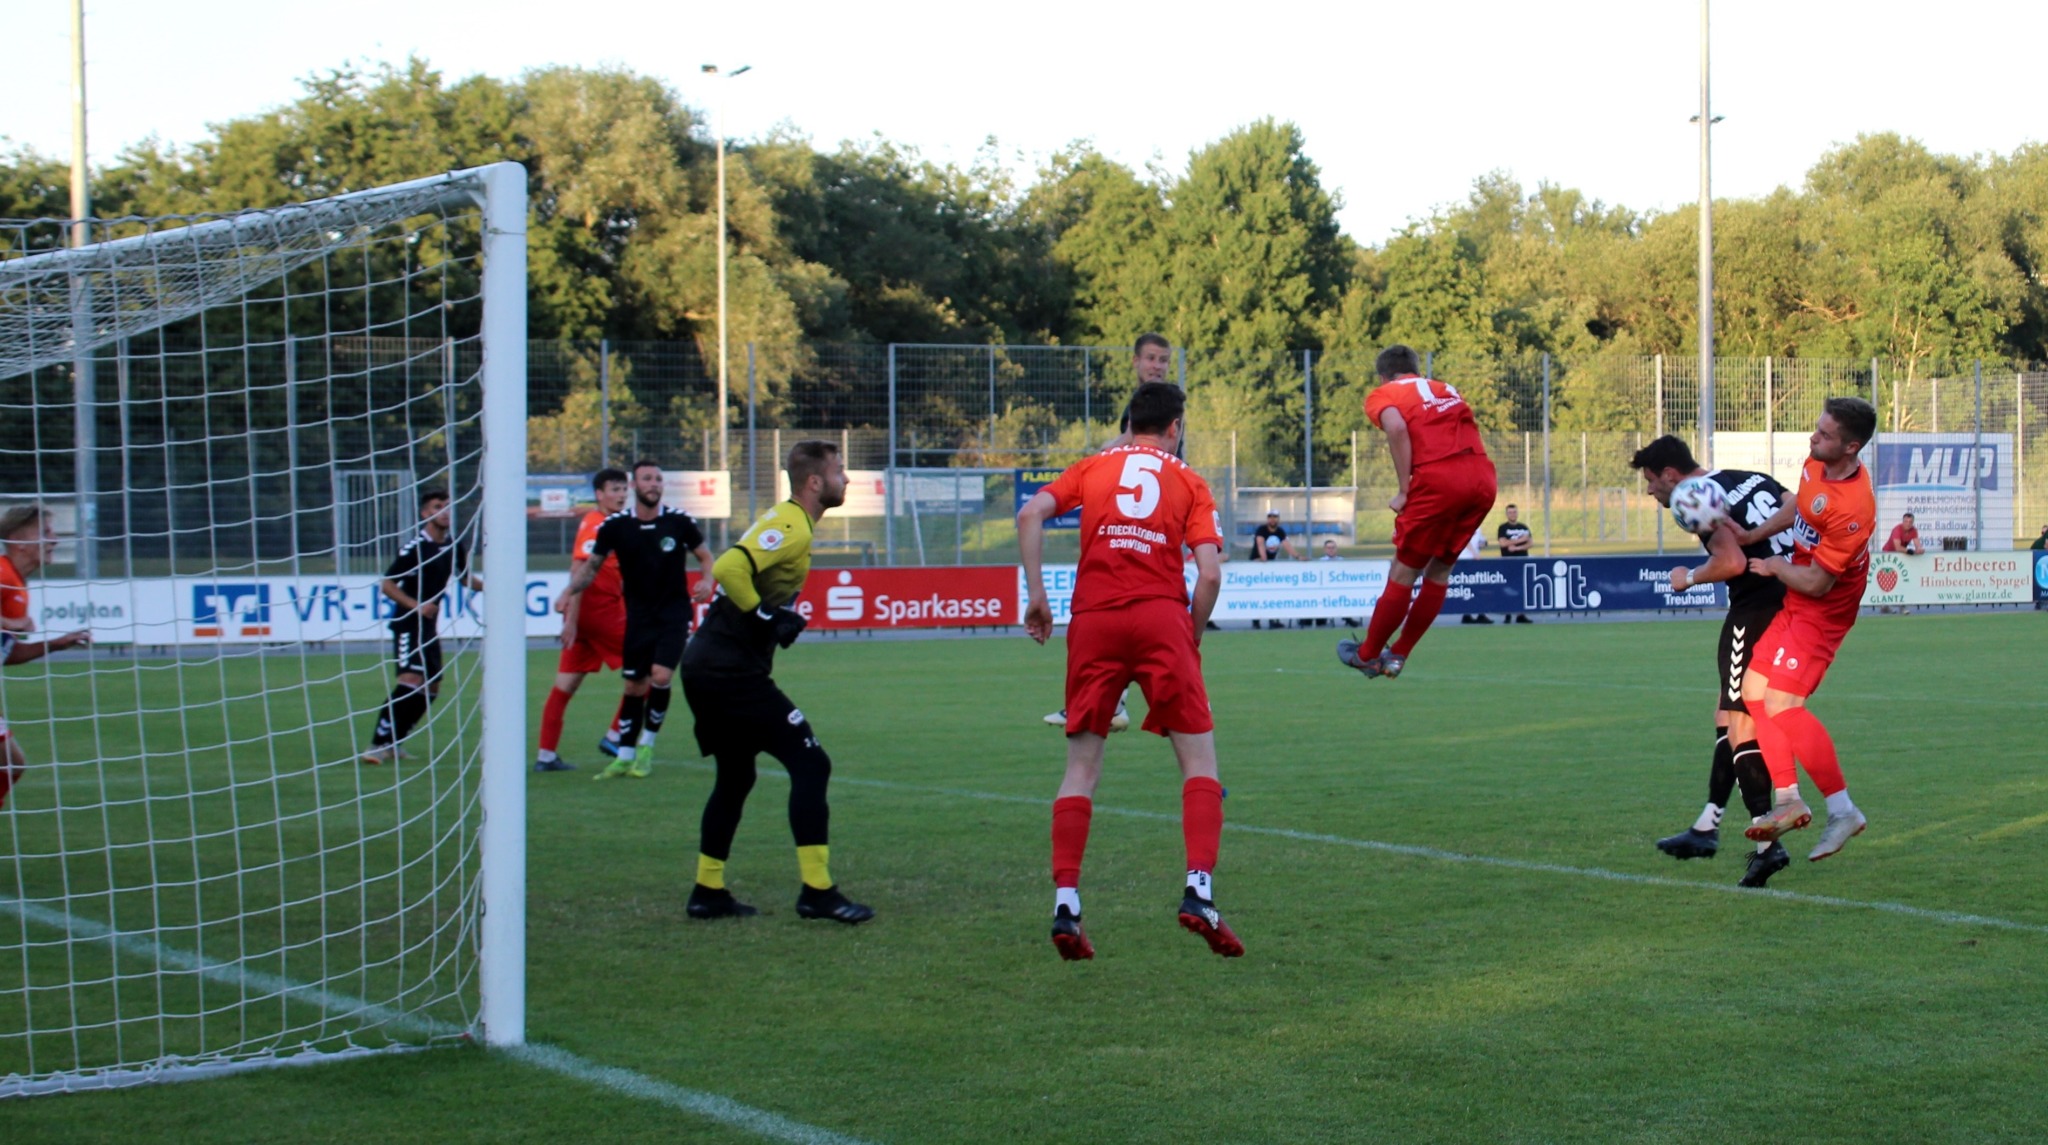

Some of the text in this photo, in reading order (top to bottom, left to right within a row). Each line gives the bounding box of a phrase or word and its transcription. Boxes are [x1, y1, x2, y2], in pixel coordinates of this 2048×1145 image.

[1908, 447, 1994, 487] MUP
[1115, 453, 1163, 519] 5
[1907, 506, 1977, 514] BAUMANAGEMEN
[1934, 557, 2017, 573] Erdbeeren
[1226, 570, 1382, 586] Ziegeleiweg 8b Schwerin
[1523, 560, 1602, 610] hit.
[1989, 575, 2030, 589] Spargel
[288, 584, 480, 621] VR-Bnk
[1664, 593, 1716, 605] Treuhand
[1869, 594, 1904, 603] GLANTZ
[1938, 589, 2013, 601] www.glantz.de
[40, 601, 124, 625] polytan
[874, 593, 1002, 625] Sparkasse
